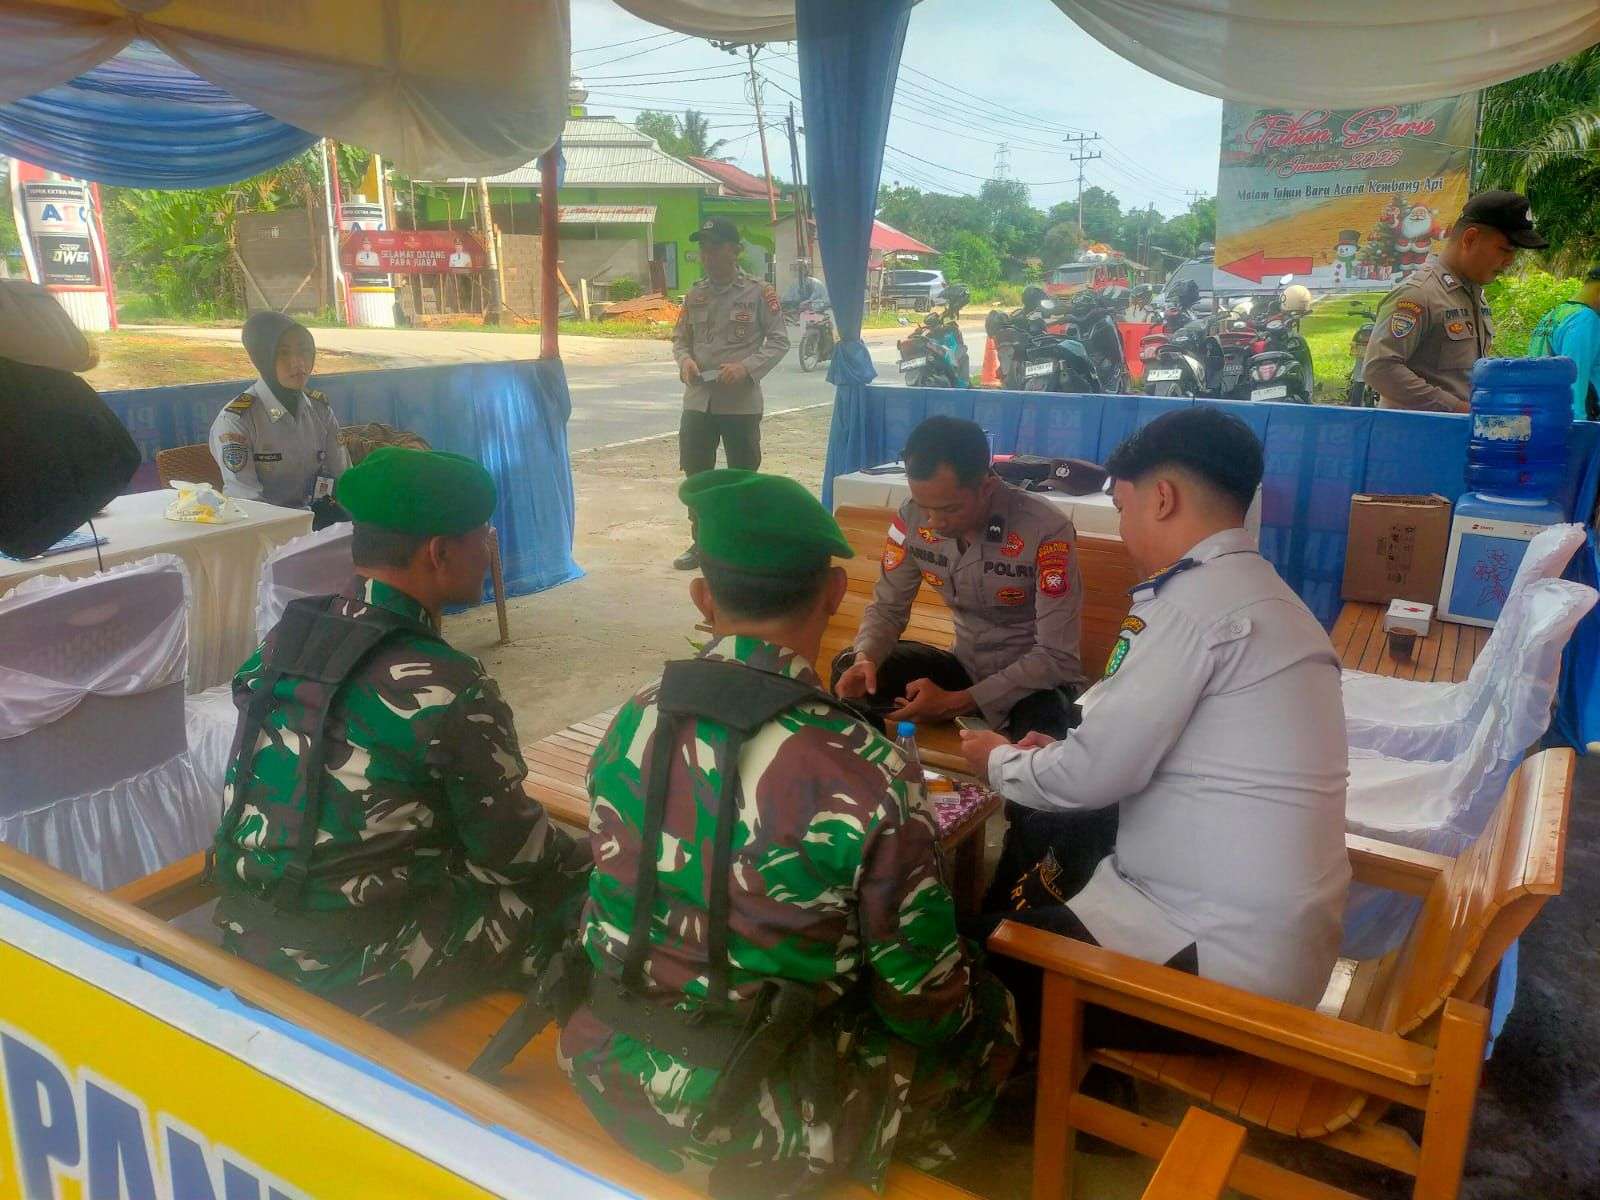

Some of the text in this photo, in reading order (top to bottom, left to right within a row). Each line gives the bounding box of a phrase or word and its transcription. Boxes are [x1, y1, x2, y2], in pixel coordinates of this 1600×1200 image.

[1341, 105, 1435, 148] Baru
[1237, 177, 1443, 201] Malam Tahun Baru Acara Kembang Api
[381, 250, 446, 259] SELAMAT DATANG
[390, 258, 411, 267] PARA
